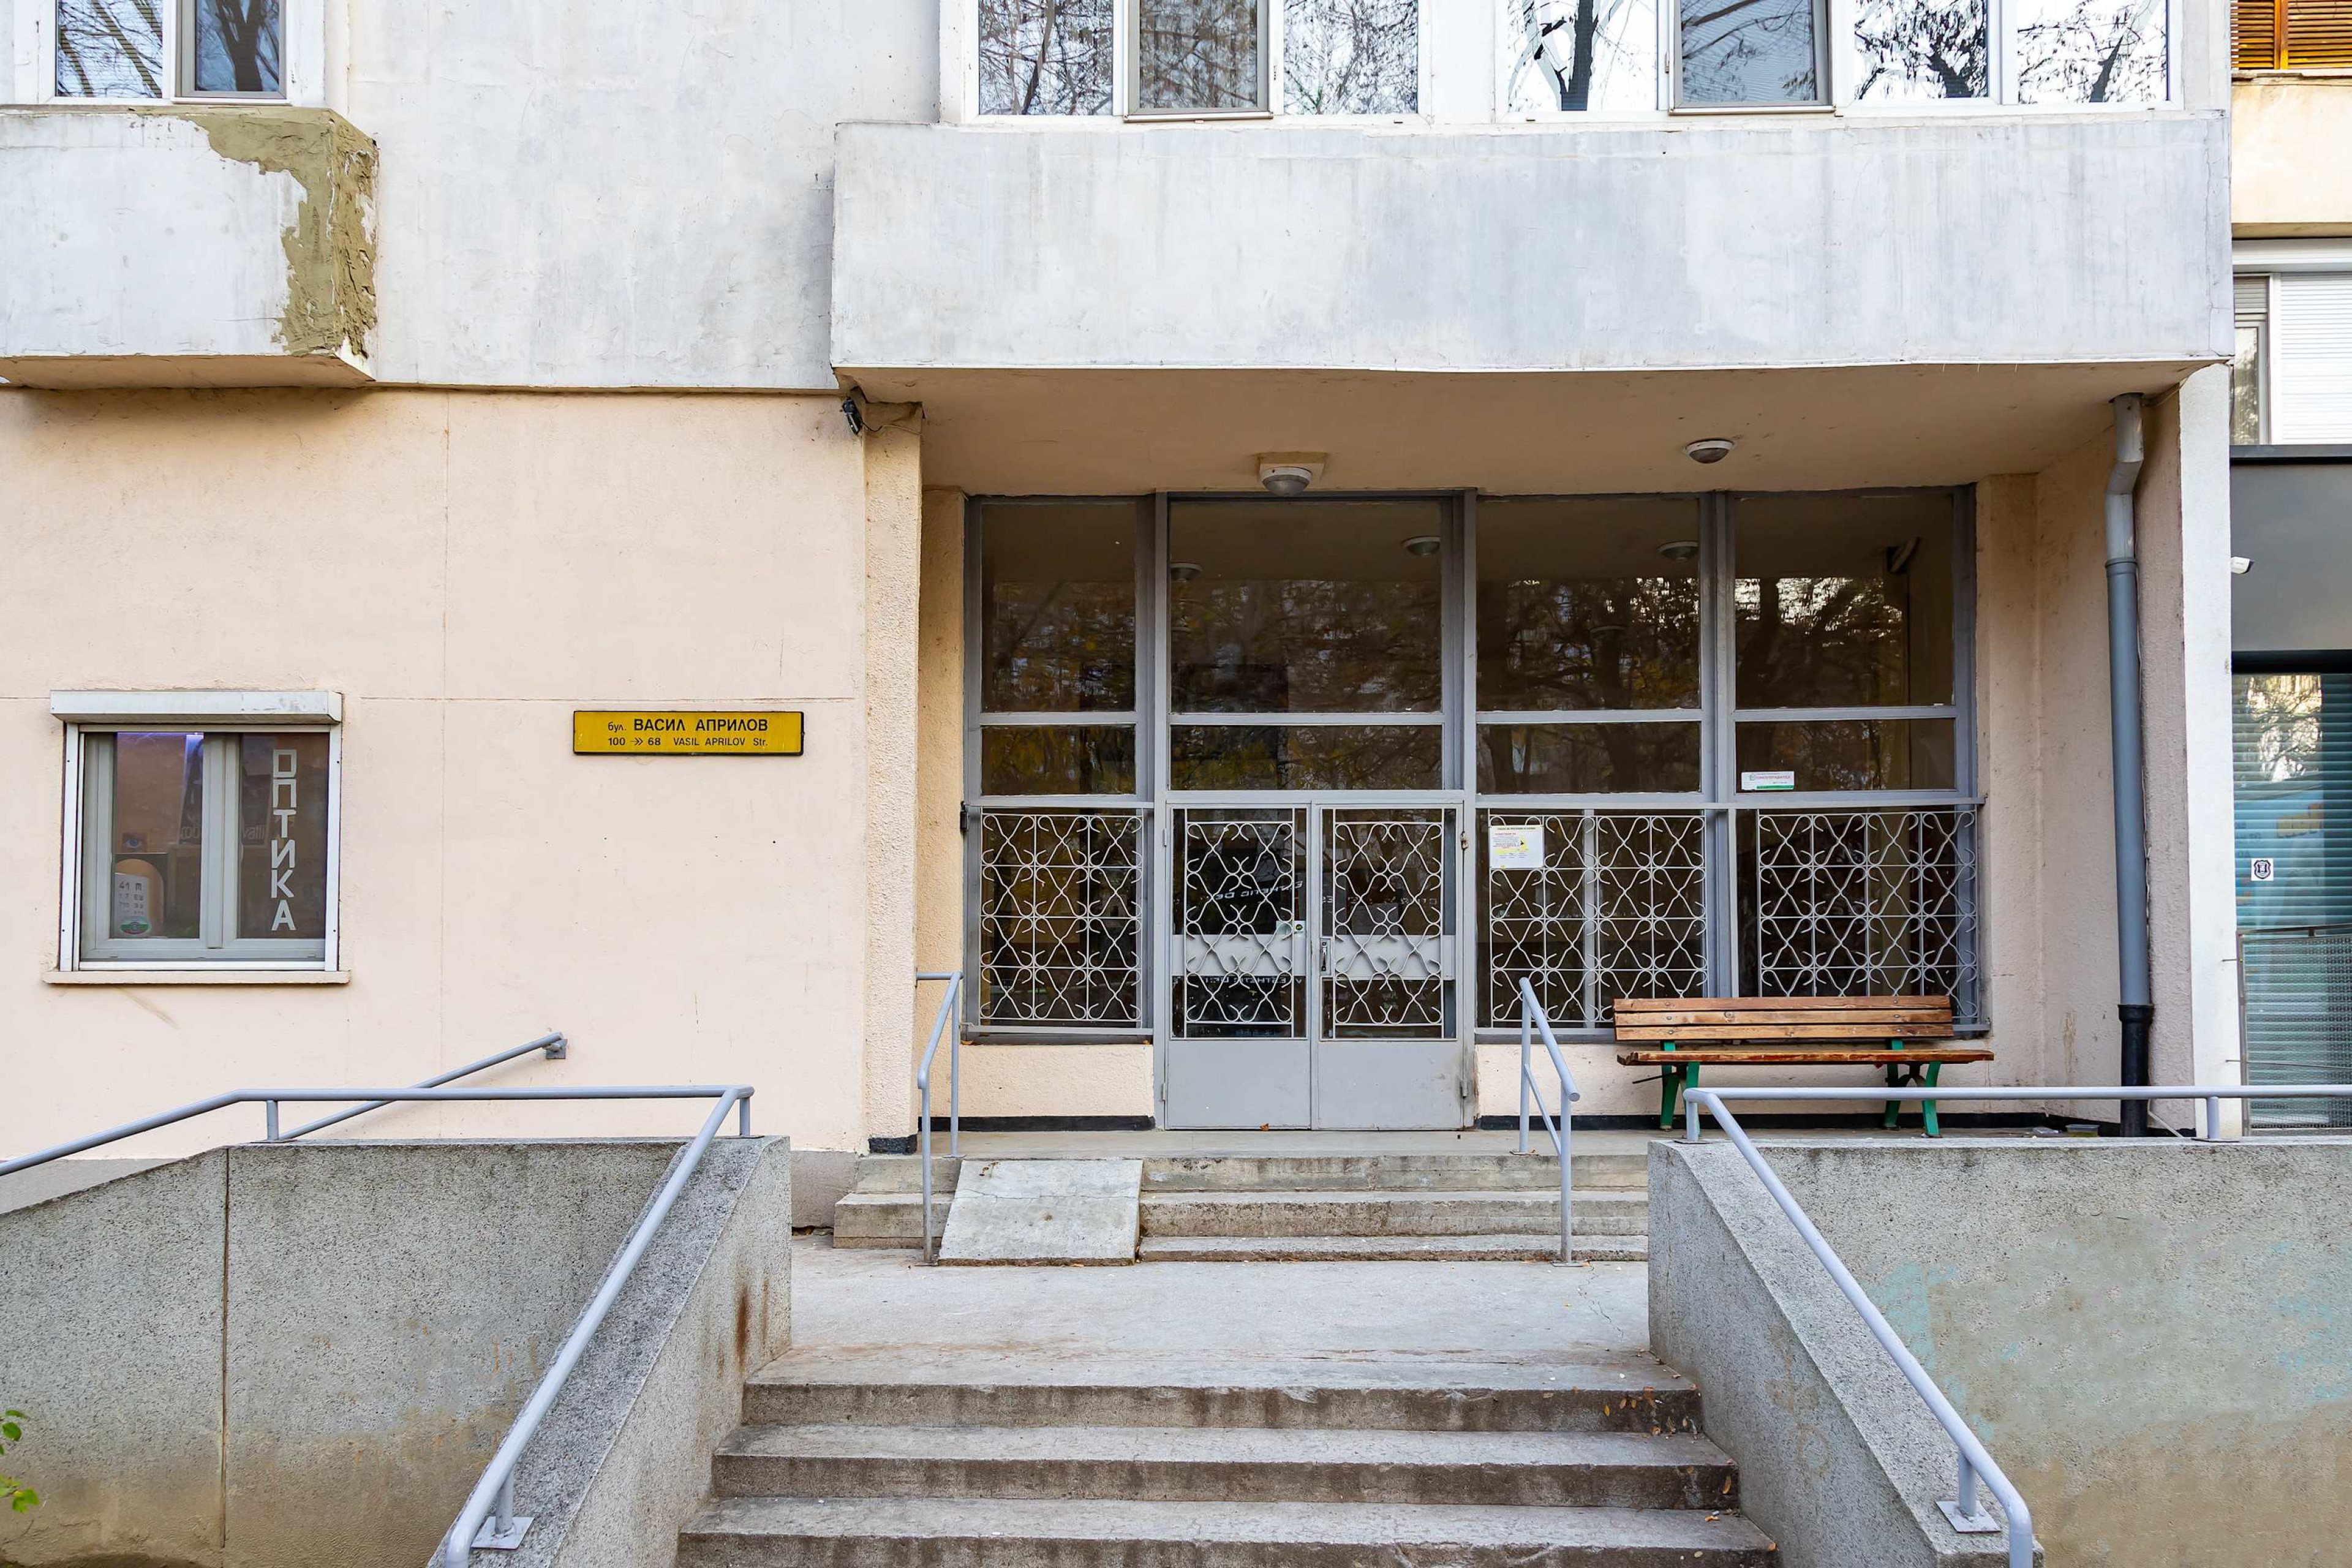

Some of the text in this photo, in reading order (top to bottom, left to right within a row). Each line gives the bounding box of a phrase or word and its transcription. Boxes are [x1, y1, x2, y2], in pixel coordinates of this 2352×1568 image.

[608, 718, 768, 733] бул. ВАСИЛ АПРИЛОВ
[608, 737, 768, 746] 100 68 VASIL APRILOV Str.
[271, 749, 297, 931] ОПТИКА
